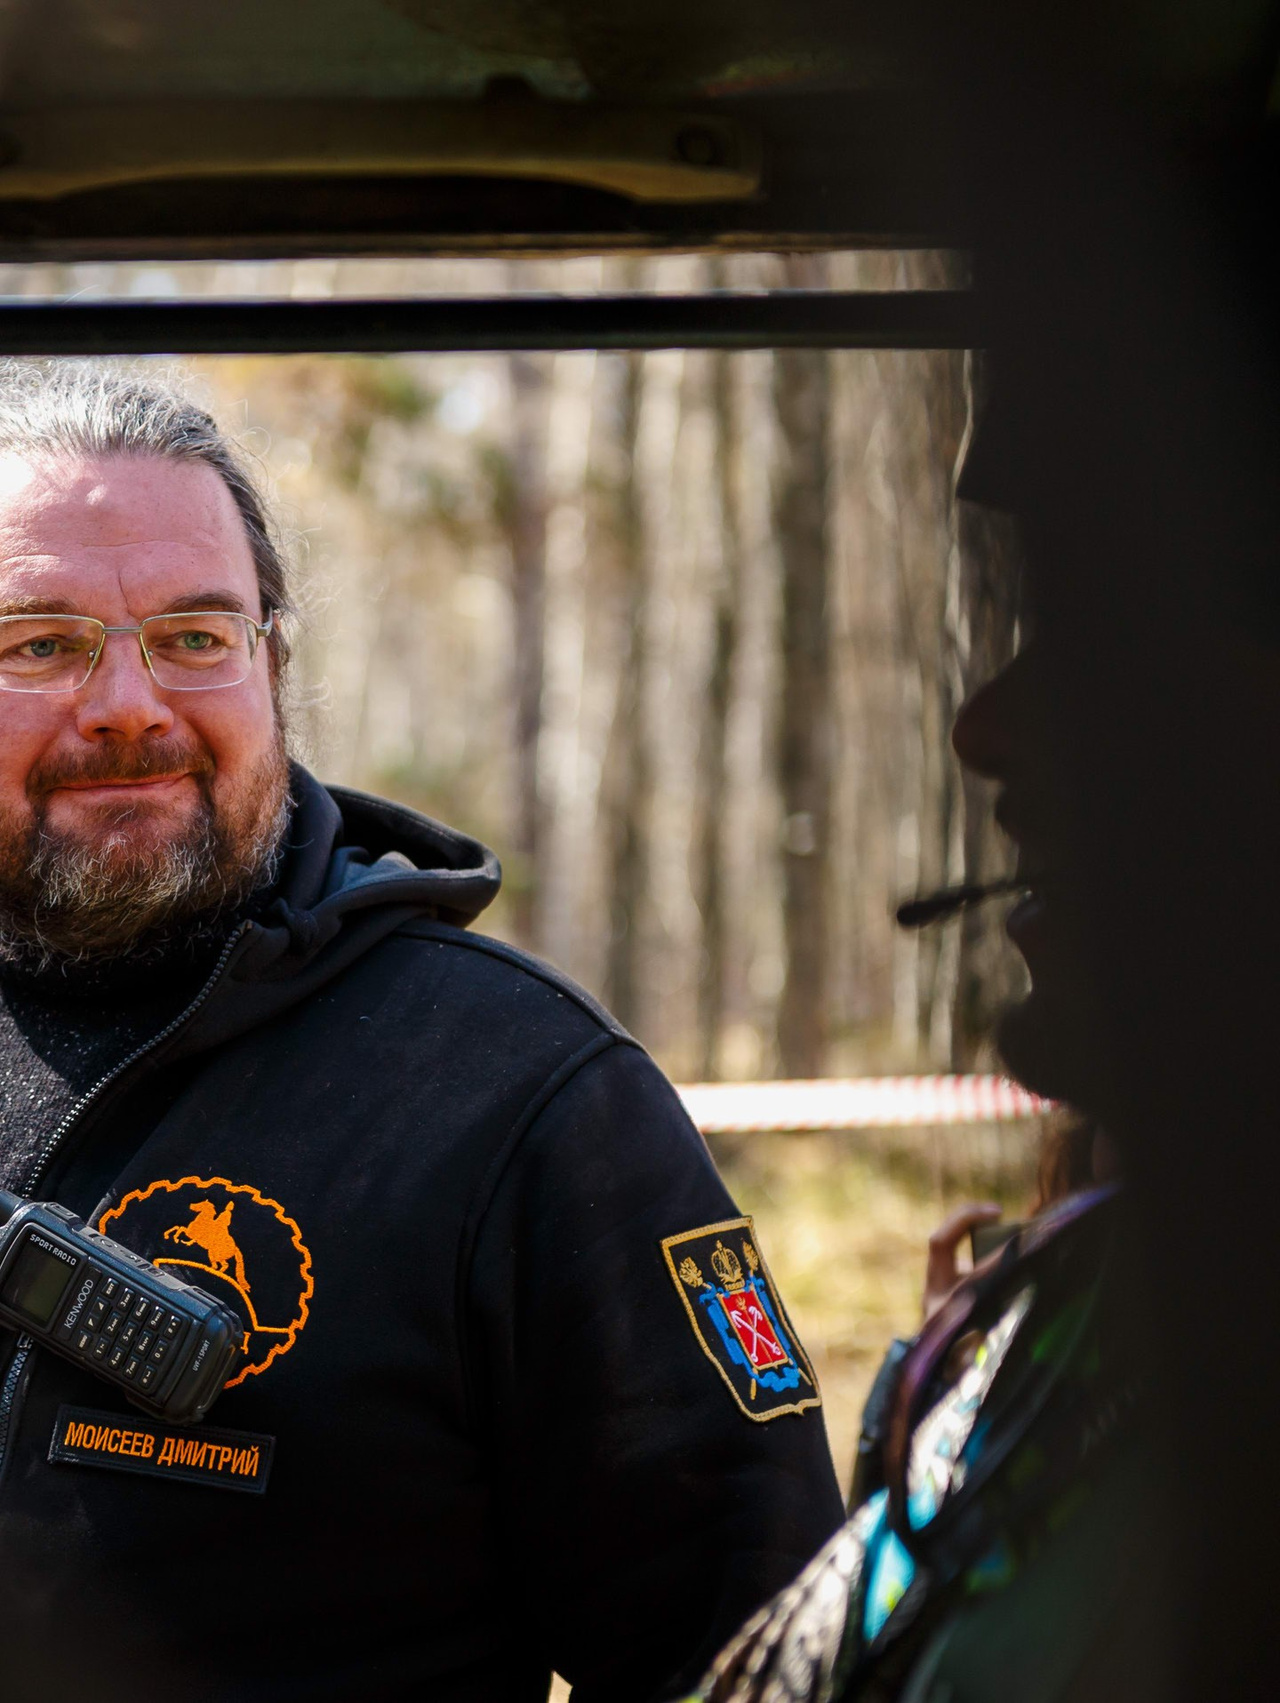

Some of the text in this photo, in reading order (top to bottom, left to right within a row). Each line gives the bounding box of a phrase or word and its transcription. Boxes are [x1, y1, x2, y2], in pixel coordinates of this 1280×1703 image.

[29, 1233, 77, 1266] SPORT RADIO
[64, 1279, 94, 1329] KENWOOD
[199, 1339, 211, 1357] SPORT
[64, 1421, 260, 1477] МОИСЕЕВ ДМИТРИЙ
